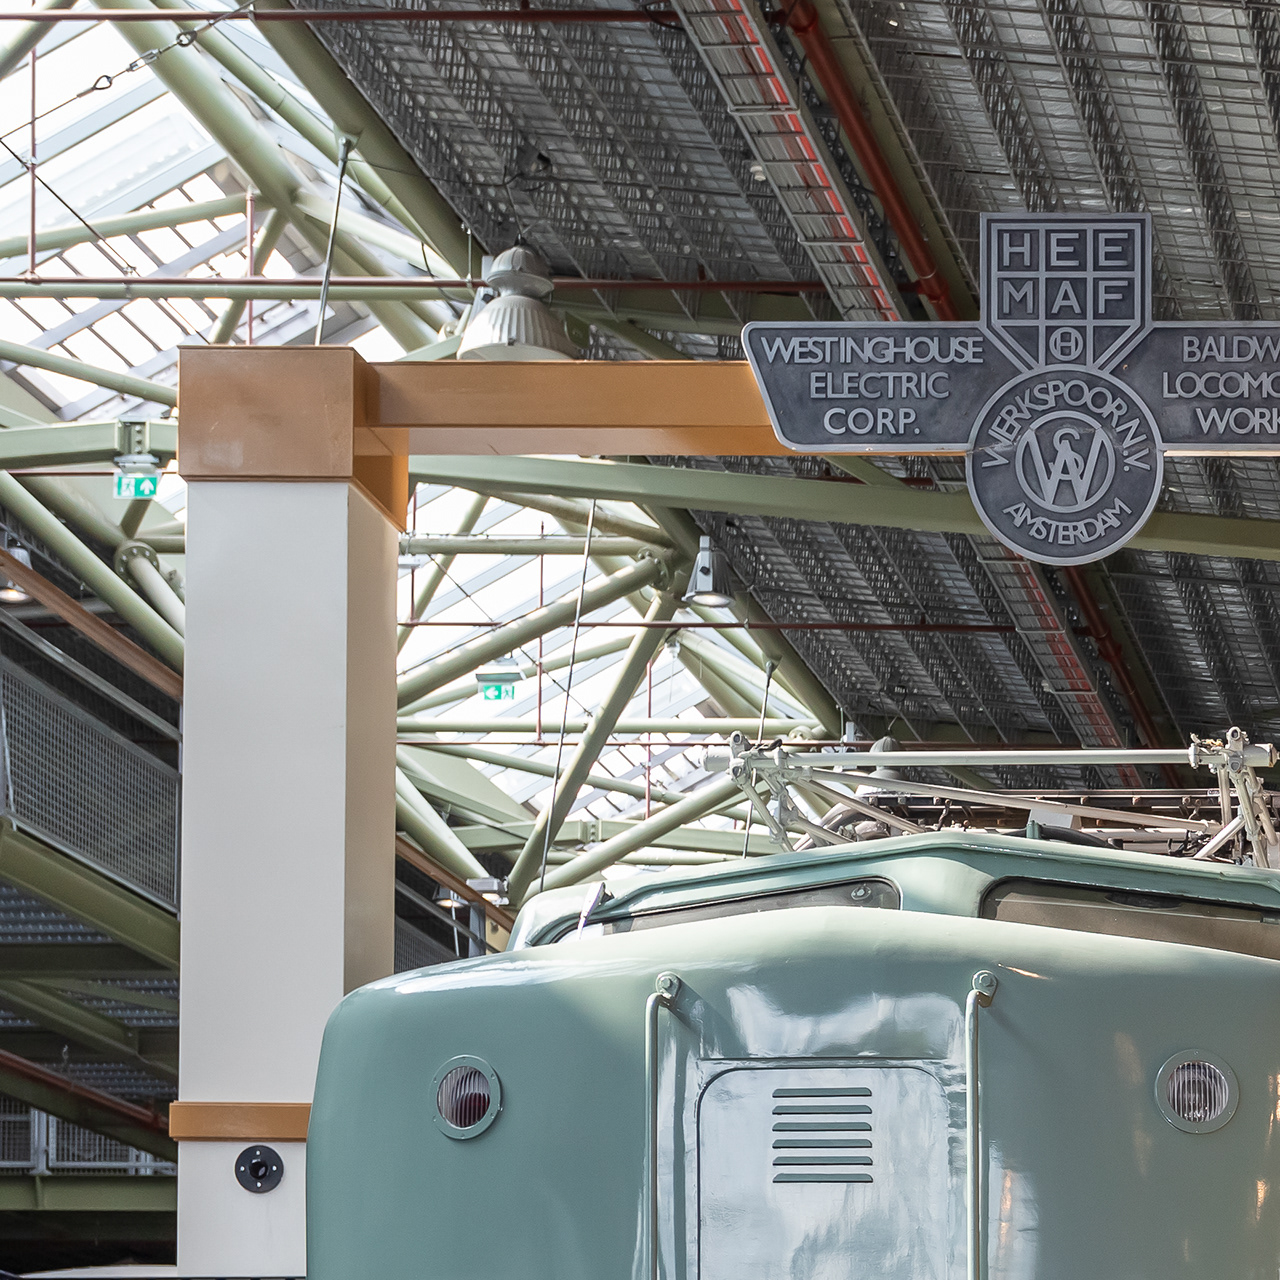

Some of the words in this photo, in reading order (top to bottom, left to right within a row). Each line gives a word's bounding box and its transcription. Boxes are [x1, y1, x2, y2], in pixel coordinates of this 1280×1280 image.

[761, 336, 984, 365] WESTINGHOUSE
[810, 372, 950, 399] ELECTRIC
[823, 407, 920, 435] CORP.
[982, 379, 1128, 468] WERKSPOOR
[1002, 497, 1132, 545] AMSTERDAM
